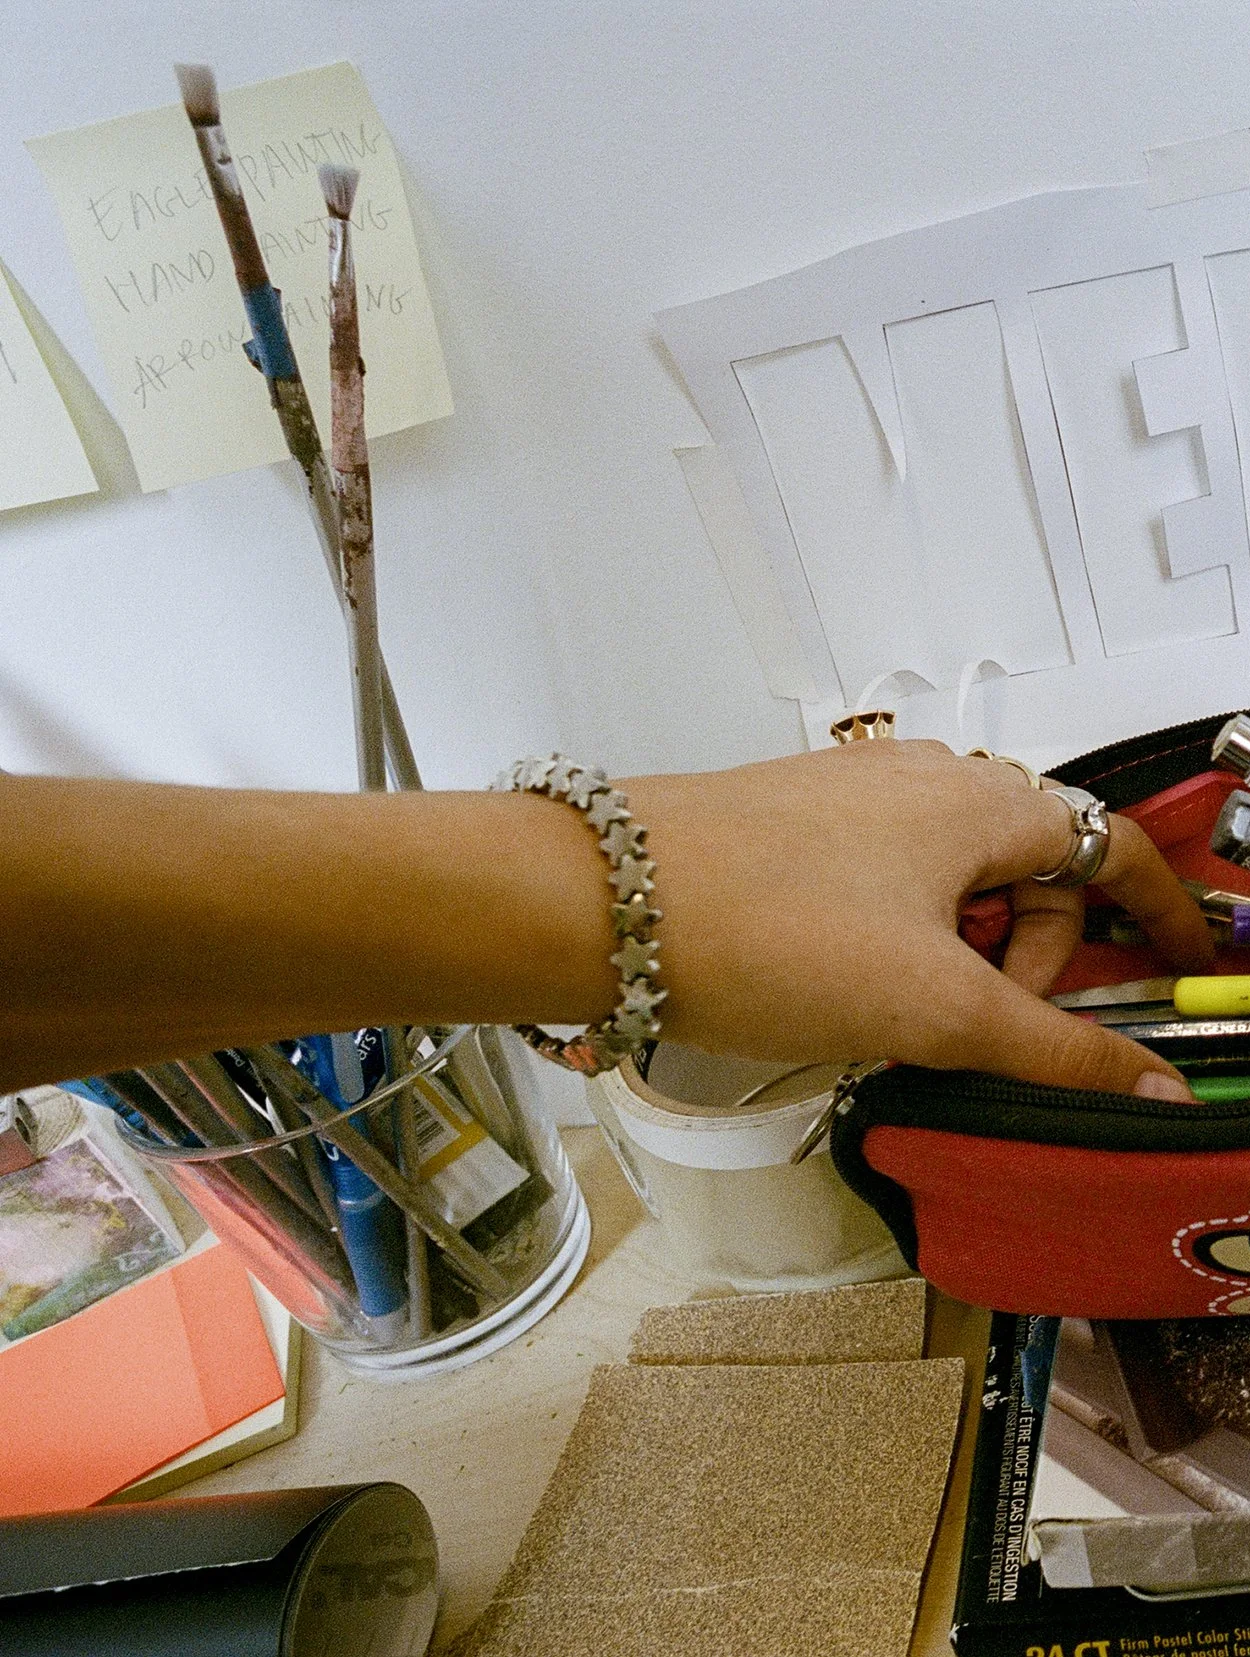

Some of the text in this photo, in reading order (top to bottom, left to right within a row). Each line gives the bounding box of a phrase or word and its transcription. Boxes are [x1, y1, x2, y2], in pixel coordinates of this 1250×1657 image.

[104, 250, 215, 313] HAND
[1014, 1447, 1029, 1479] NOCIF
[1012, 1480, 1027, 1496] EN
[1009, 1499, 1025, 1522] CAS
[994, 1512, 1007, 1532] DOS
[992, 1533, 1005, 1546] DE
[1002, 1525, 1023, 1602] D'INGESTION
[1120, 1638, 1149, 1650] Firm
[1153, 1631, 1192, 1649] Pastel
[1196, 1629, 1230, 1645] Color
